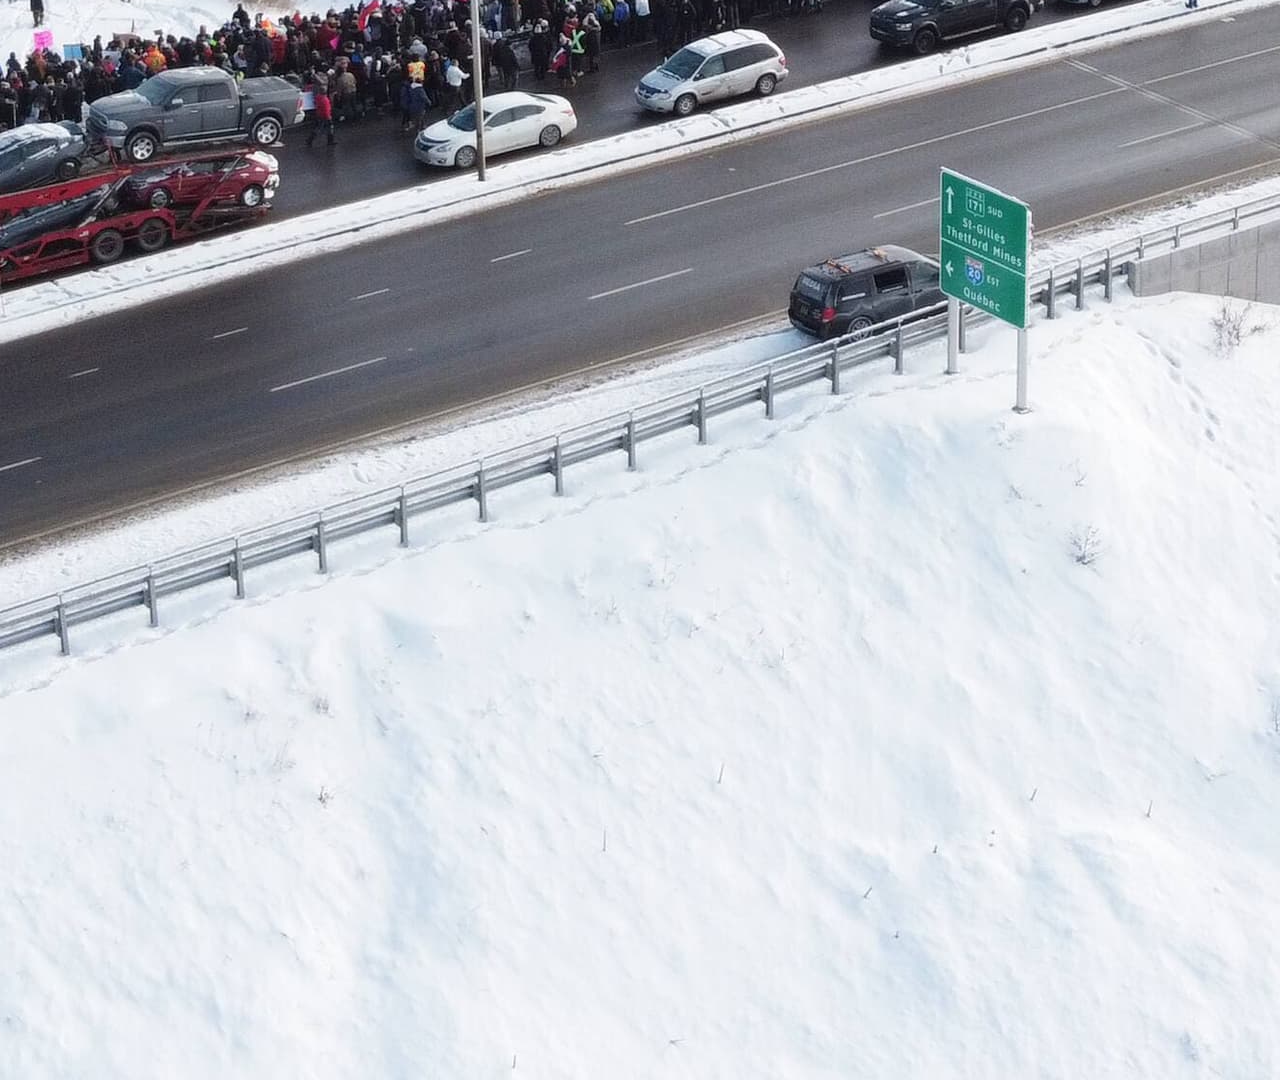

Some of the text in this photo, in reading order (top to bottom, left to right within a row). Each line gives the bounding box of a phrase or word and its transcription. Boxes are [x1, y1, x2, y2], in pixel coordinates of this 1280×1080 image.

[968, 199, 1003, 218] 171 SUD
[962, 217, 1006, 245] St-Gilles
[946, 225, 1022, 266] Thetford Mines
[968, 267, 999, 287] 20 EST
[963, 286, 1001, 312] Québec
